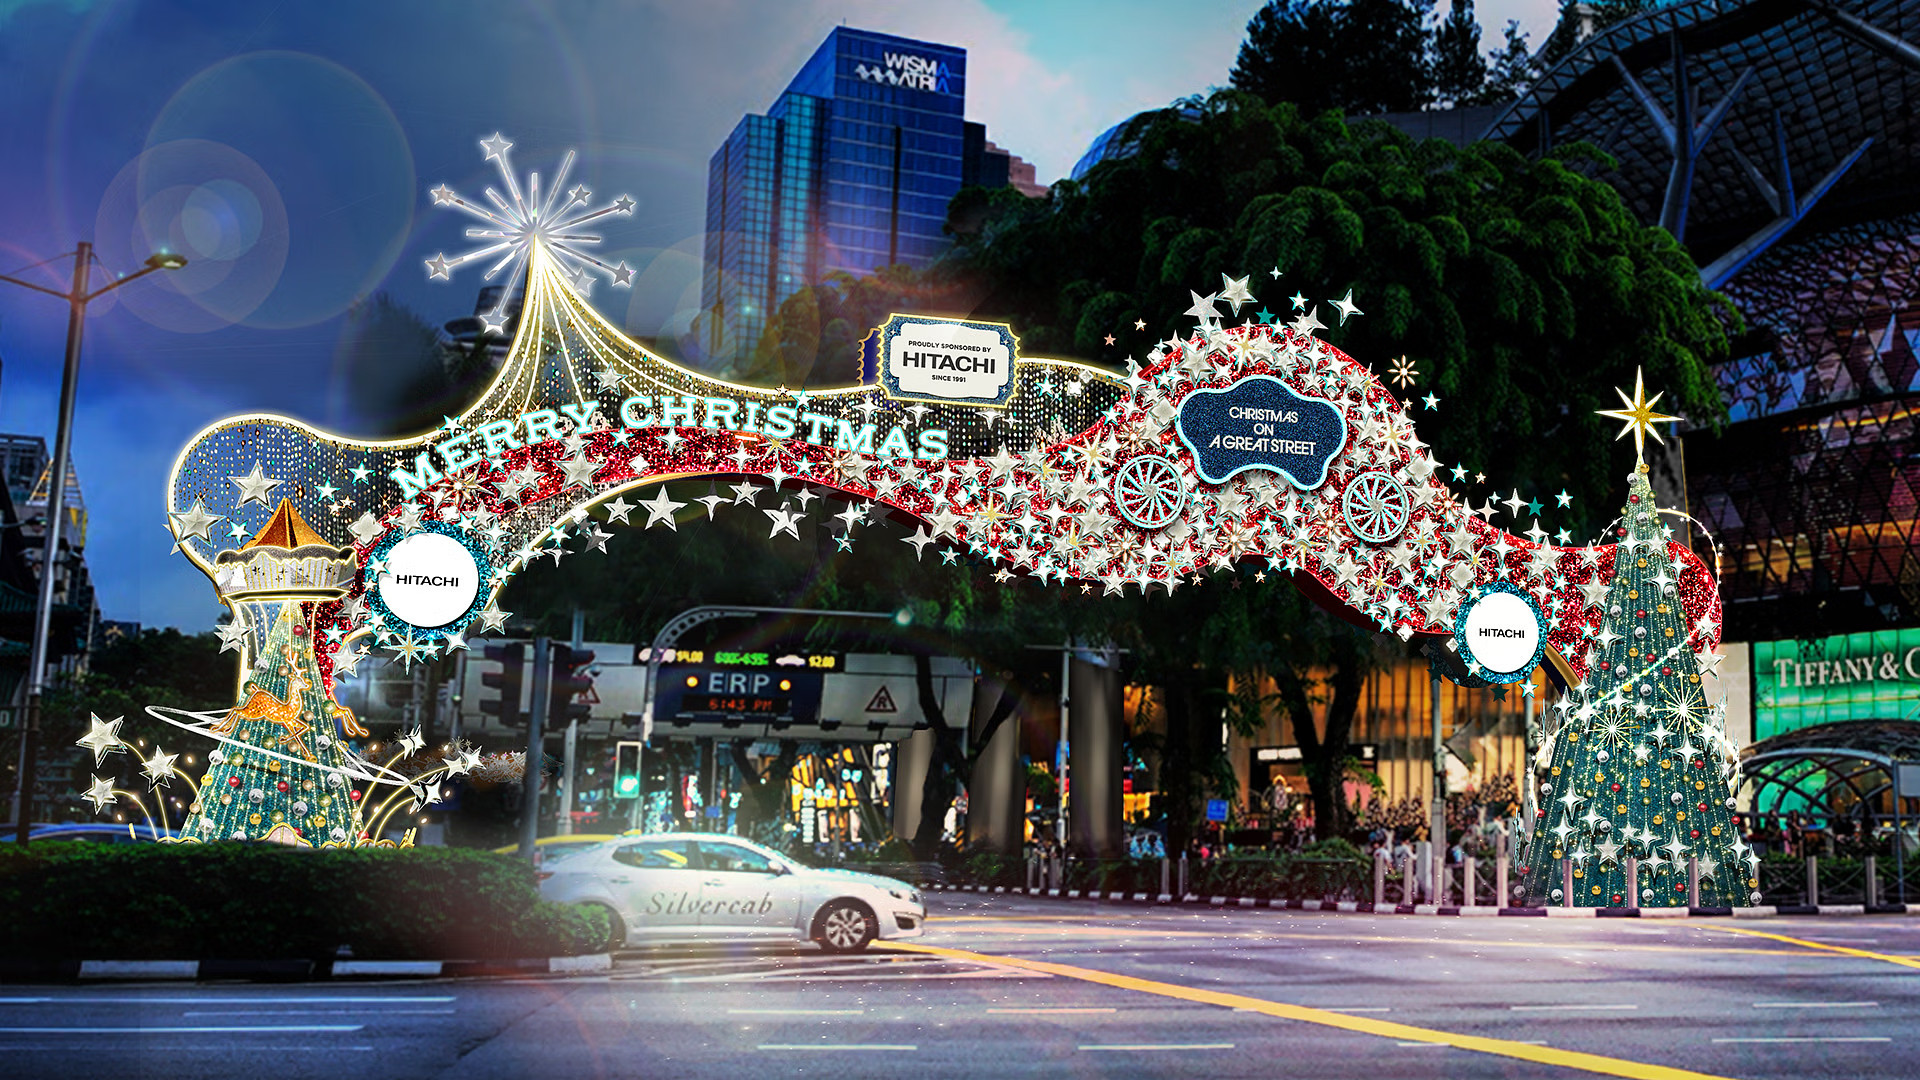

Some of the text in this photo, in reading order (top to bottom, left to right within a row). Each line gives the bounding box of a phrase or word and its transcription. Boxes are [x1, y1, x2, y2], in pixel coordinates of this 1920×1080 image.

[884, 51, 950, 79] WISMA
[898, 71, 950, 94] ATRIA
[908, 340, 940, 349] PROUDLY
[940, 343, 981, 352] SPONSORED
[903, 351, 996, 374] HITACHI
[931, 374, 951, 382] SINCE
[1229, 406, 1299, 424] CHRISTMAS
[1253, 423, 1274, 436] ON
[389, 394, 949, 500] MERRY CHRISTMAS
[1209, 434, 1317, 456] A GREAT STREET
[396, 574, 459, 587] HITACHI
[1479, 628, 1525, 639] HITACHI
[646, 891, 773, 915] Silvercab
